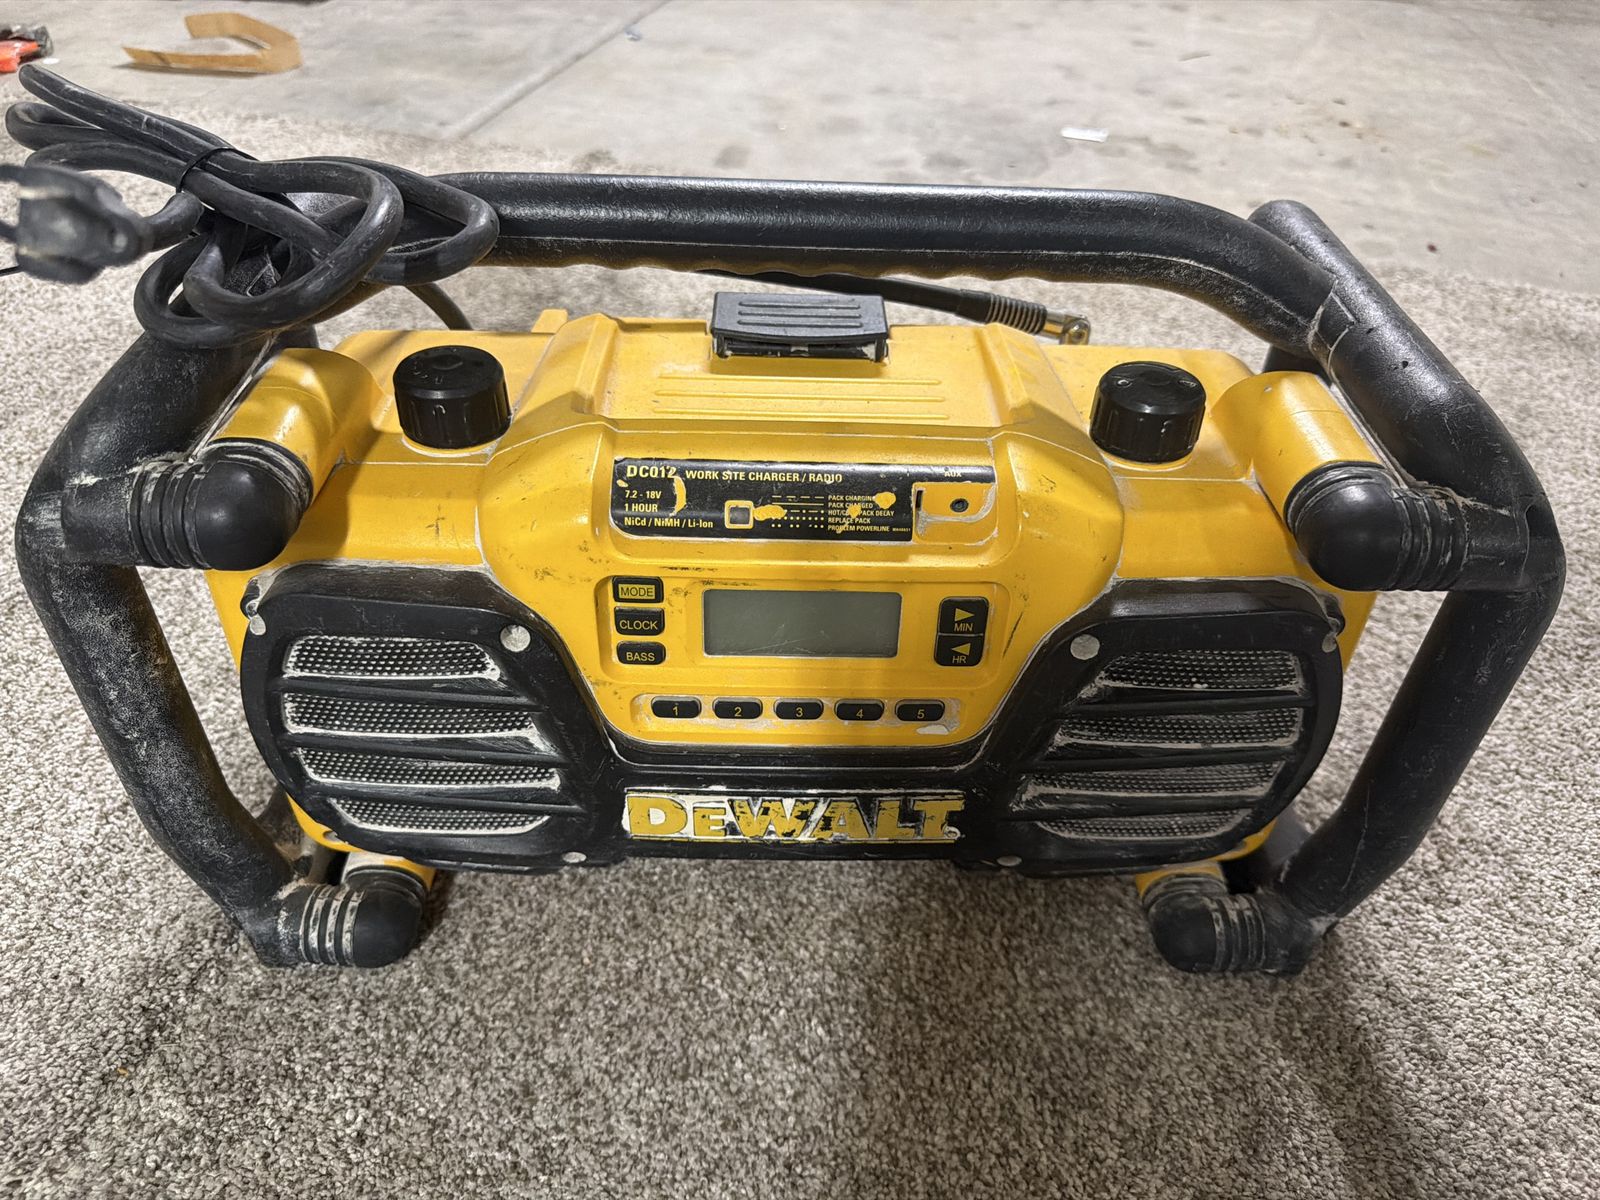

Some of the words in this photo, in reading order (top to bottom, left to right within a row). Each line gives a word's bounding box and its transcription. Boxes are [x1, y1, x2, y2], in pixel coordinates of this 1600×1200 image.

[626, 465, 676, 478] DC012
[686, 470, 719, 480] WORK
[749, 472, 799, 482] CHARGER
[809, 473, 843, 483] RADIO
[625, 490, 637, 498] 7.2
[646, 491, 661, 499] 18V
[625, 504, 628, 512] 1
[632, 504, 658, 512] HOUR
[624, 518, 646, 526] NiCd
[654, 518, 679, 527] NiMH
[688, 519, 714, 528] Li-Ion
[620, 587, 654, 598] MODE
[619, 619, 658, 630] CLOCK
[954, 622, 974, 632] MIN
[626, 651, 655, 662] BASS
[952, 654, 967, 664] HR
[672, 706, 680, 716] 1
[734, 707, 742, 717] 2
[796, 707, 803, 717] 3
[856, 708, 864, 719] 4
[917, 708, 925, 719] 5
